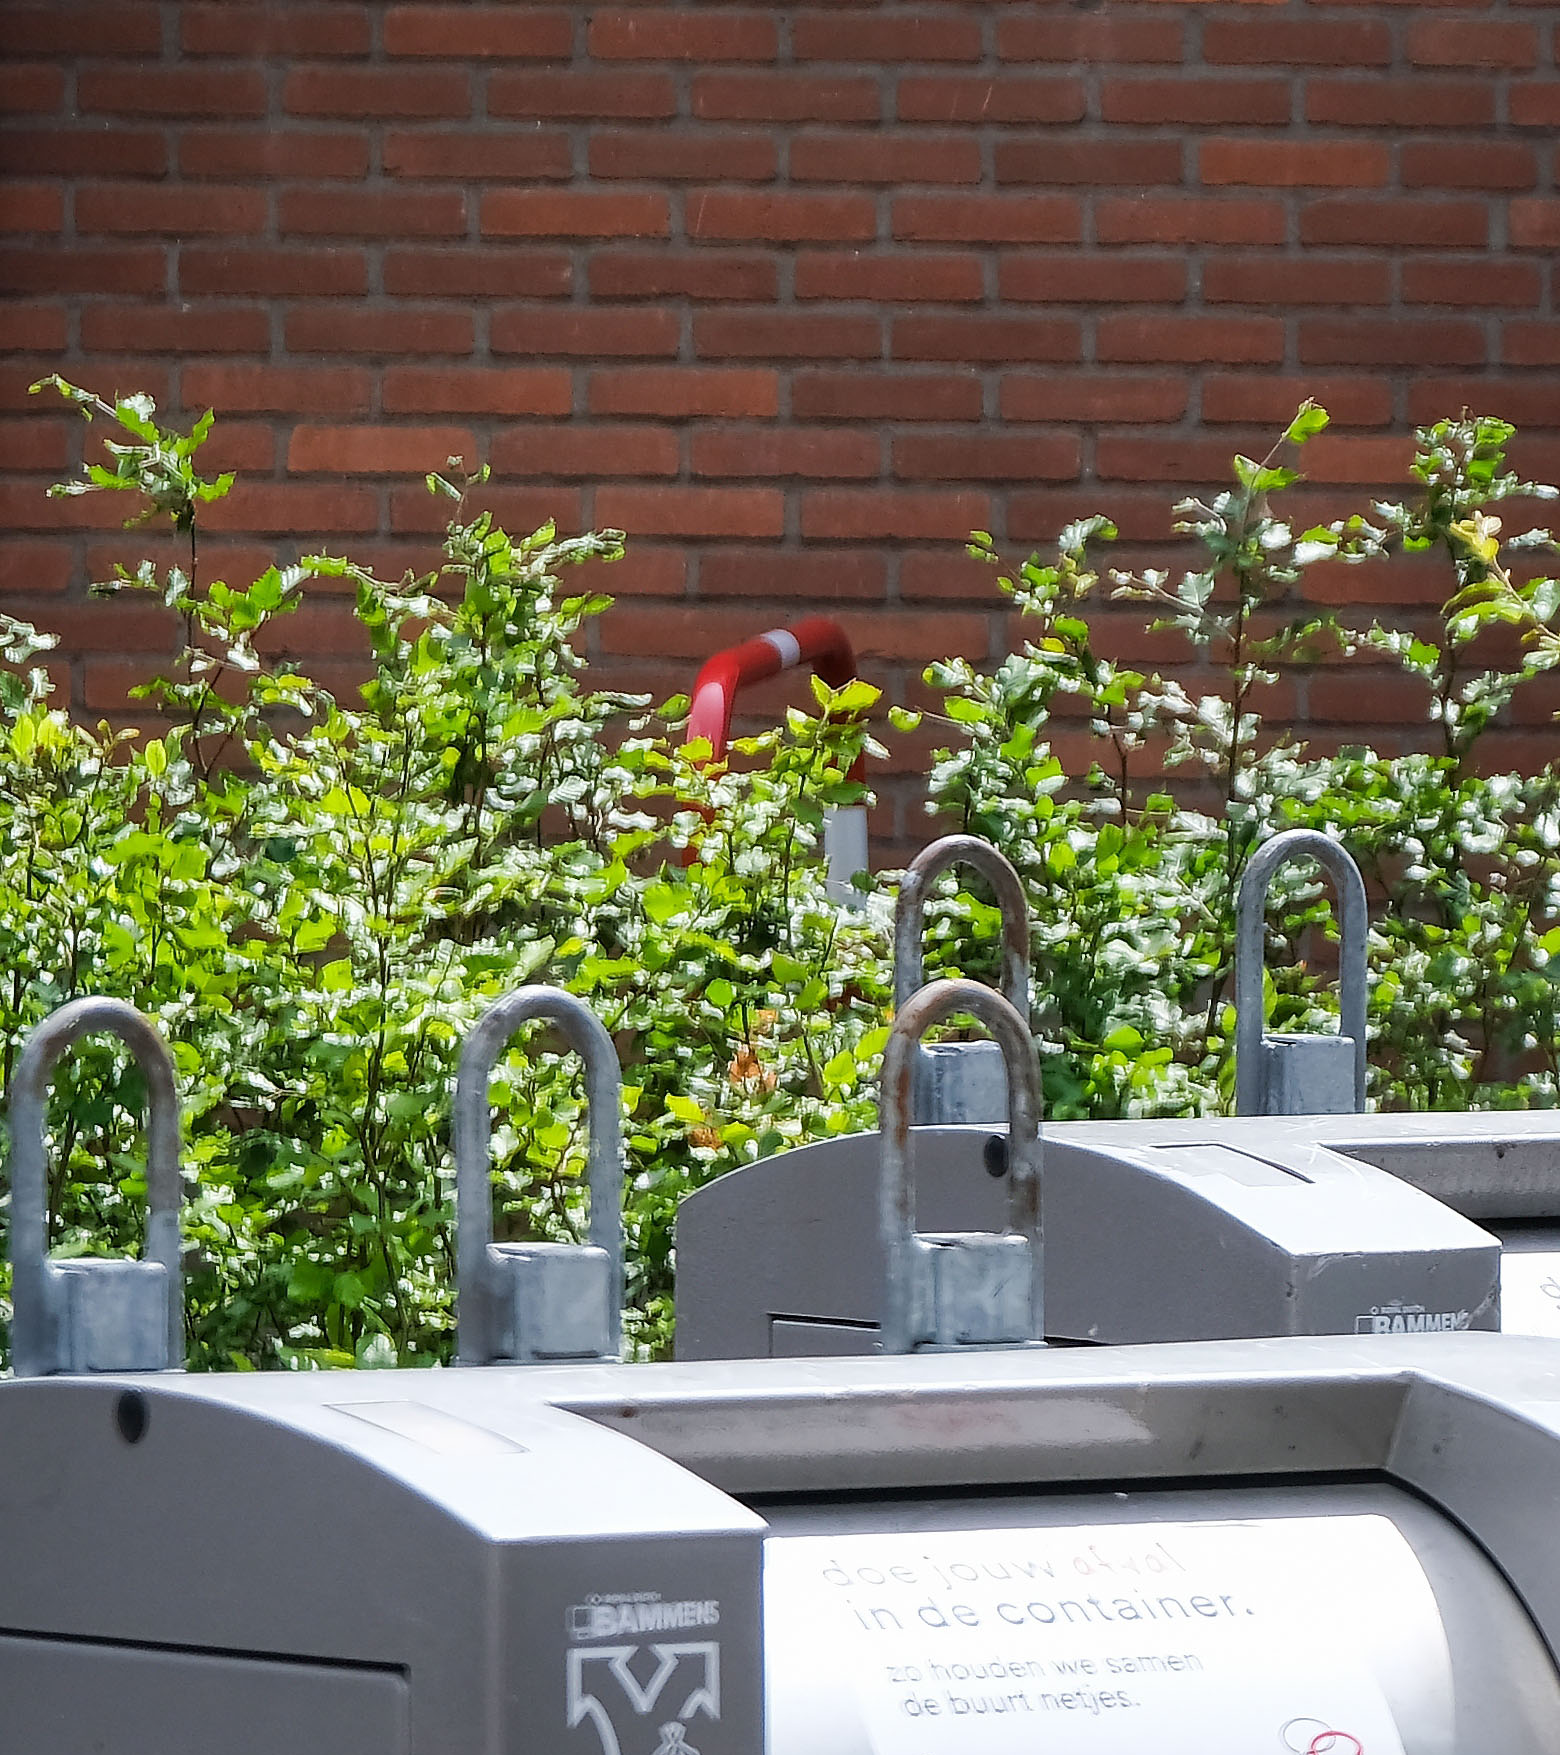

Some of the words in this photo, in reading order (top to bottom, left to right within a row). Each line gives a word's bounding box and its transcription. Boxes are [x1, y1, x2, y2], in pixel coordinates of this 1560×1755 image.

[822, 1559, 918, 1587] doe
[923, 1555, 1055, 1590] jouw
[591, 1600, 720, 1638] BAMMENS
[846, 1599, 904, 1631] in
[917, 1597, 981, 1629] de
[996, 1589, 1255, 1626] container.
[885, 1663, 923, 1683] zo
[928, 1655, 1046, 1681] houden
[1056, 1657, 1099, 1676] we
[1106, 1652, 1203, 1674] samen
[903, 1691, 940, 1717] de
[948, 1690, 1032, 1715] buurt
[1040, 1687, 1142, 1716] netjes.
